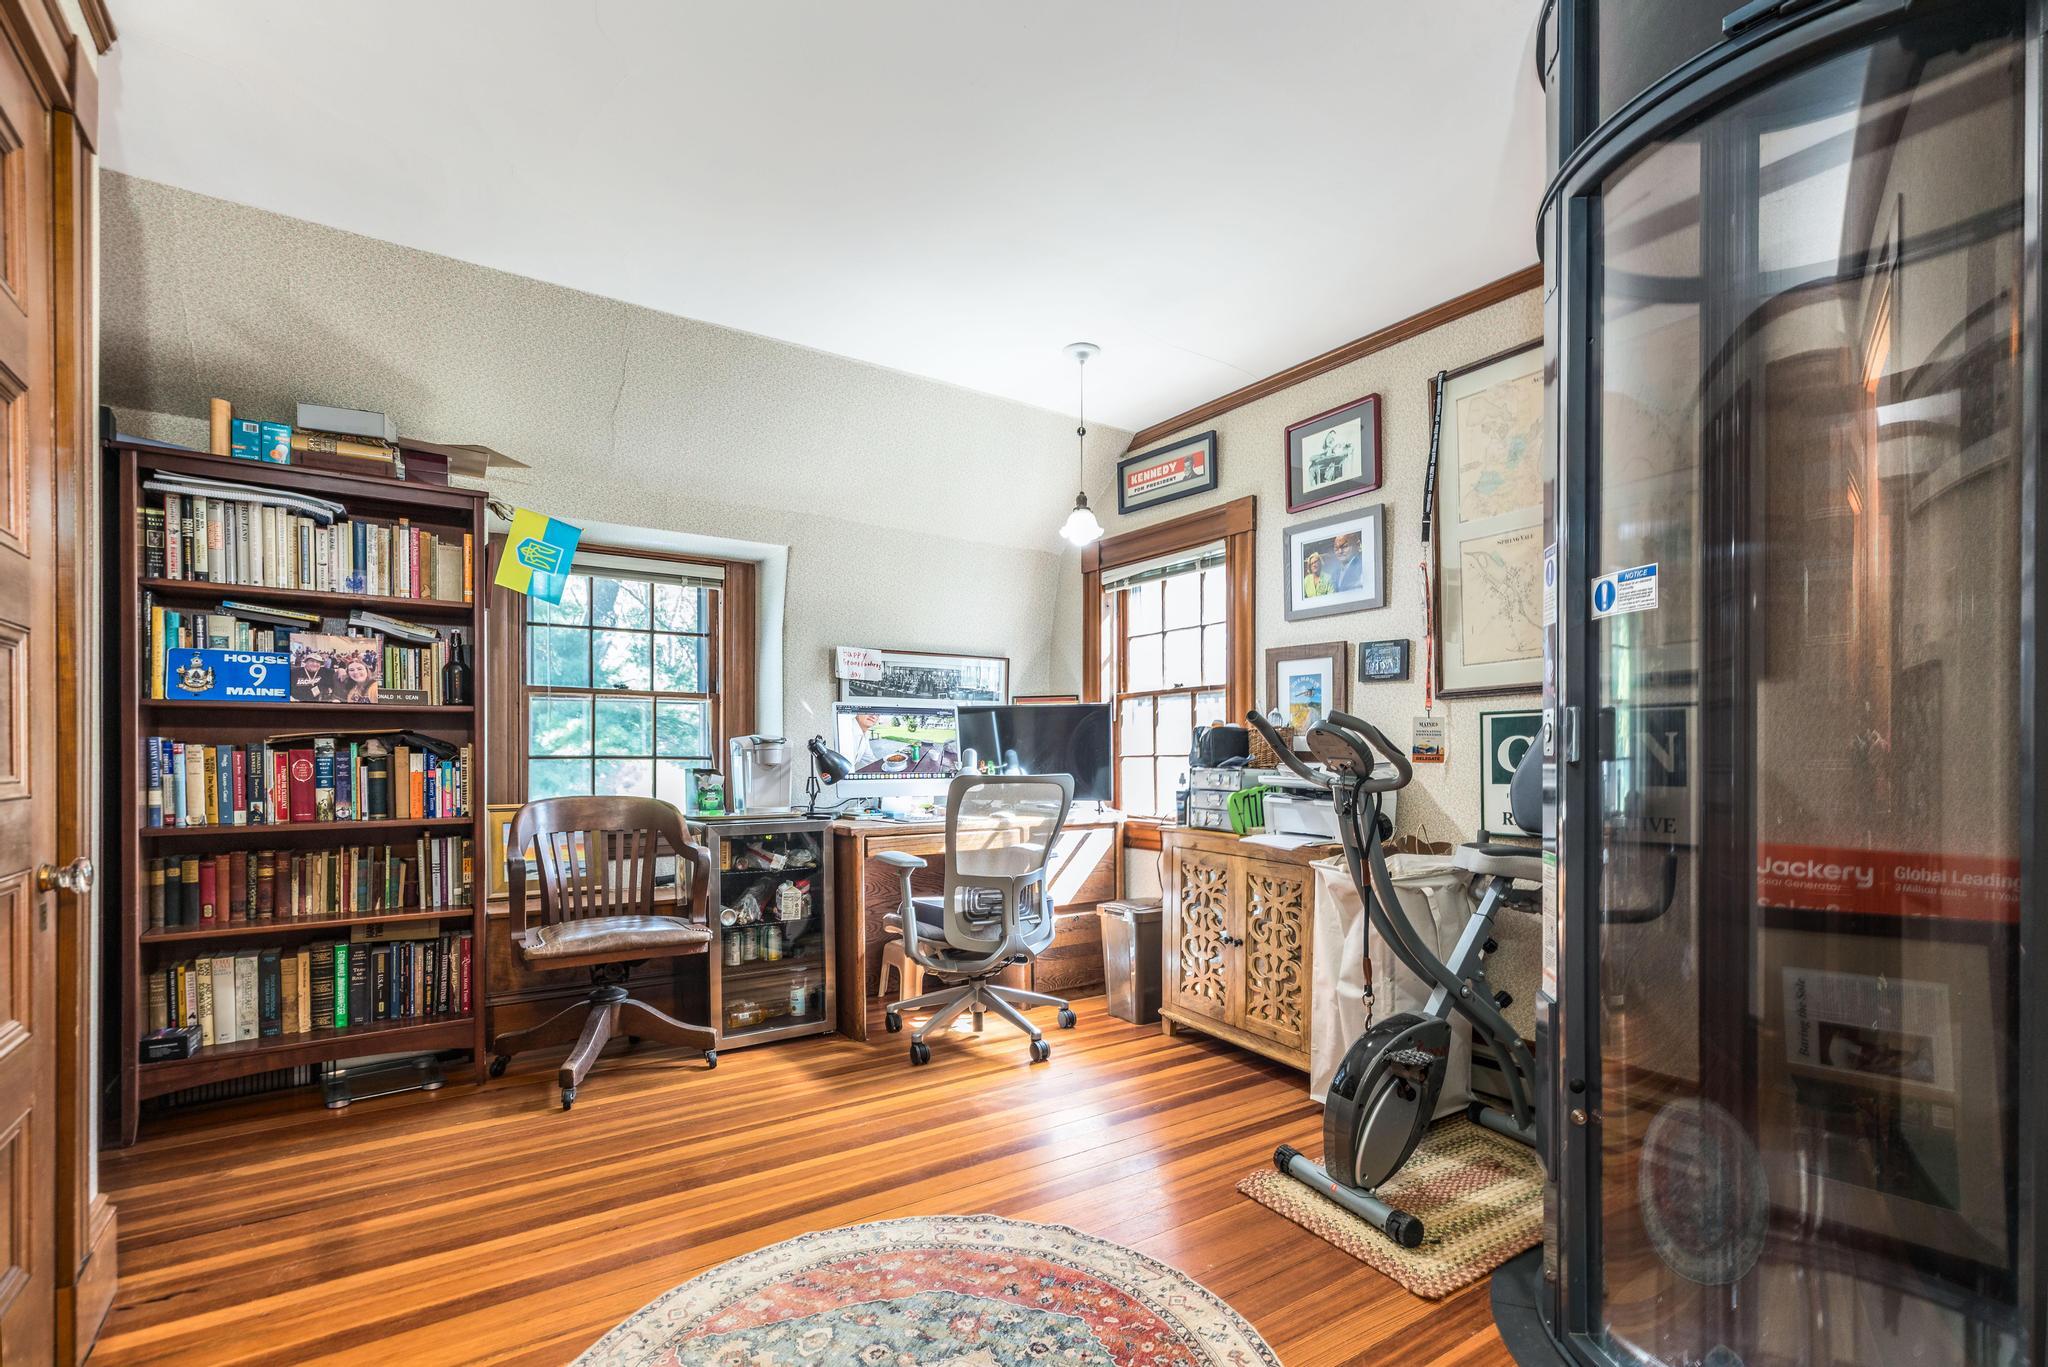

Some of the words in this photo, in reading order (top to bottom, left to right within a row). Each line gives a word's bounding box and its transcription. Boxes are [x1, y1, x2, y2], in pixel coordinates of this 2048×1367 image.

[1131, 461, 1177, 485] KENNEDY
[1146, 476, 1177, 490] PRESIDENT
[241, 522, 249, 542] LAND
[1624, 568, 1648, 580] NOTICE
[224, 653, 289, 665] HOUSE
[249, 664, 267, 687] 9
[226, 686, 286, 697] MAINE
[405, 693, 419, 701] DEAN
[149, 739, 158, 760] JIMMY
[150, 760, 159, 787] CARTER
[1757, 856, 1874, 888] Jackery
[1893, 865, 1947, 883] Global
[1952, 872, 2022, 892] Leading
[1784, 879, 1842, 893] Generator
[1795, 977, 1806, 1000] Sole
[1796, 1002, 1807, 1020] the
[1798, 1020, 1810, 1057] Baring
